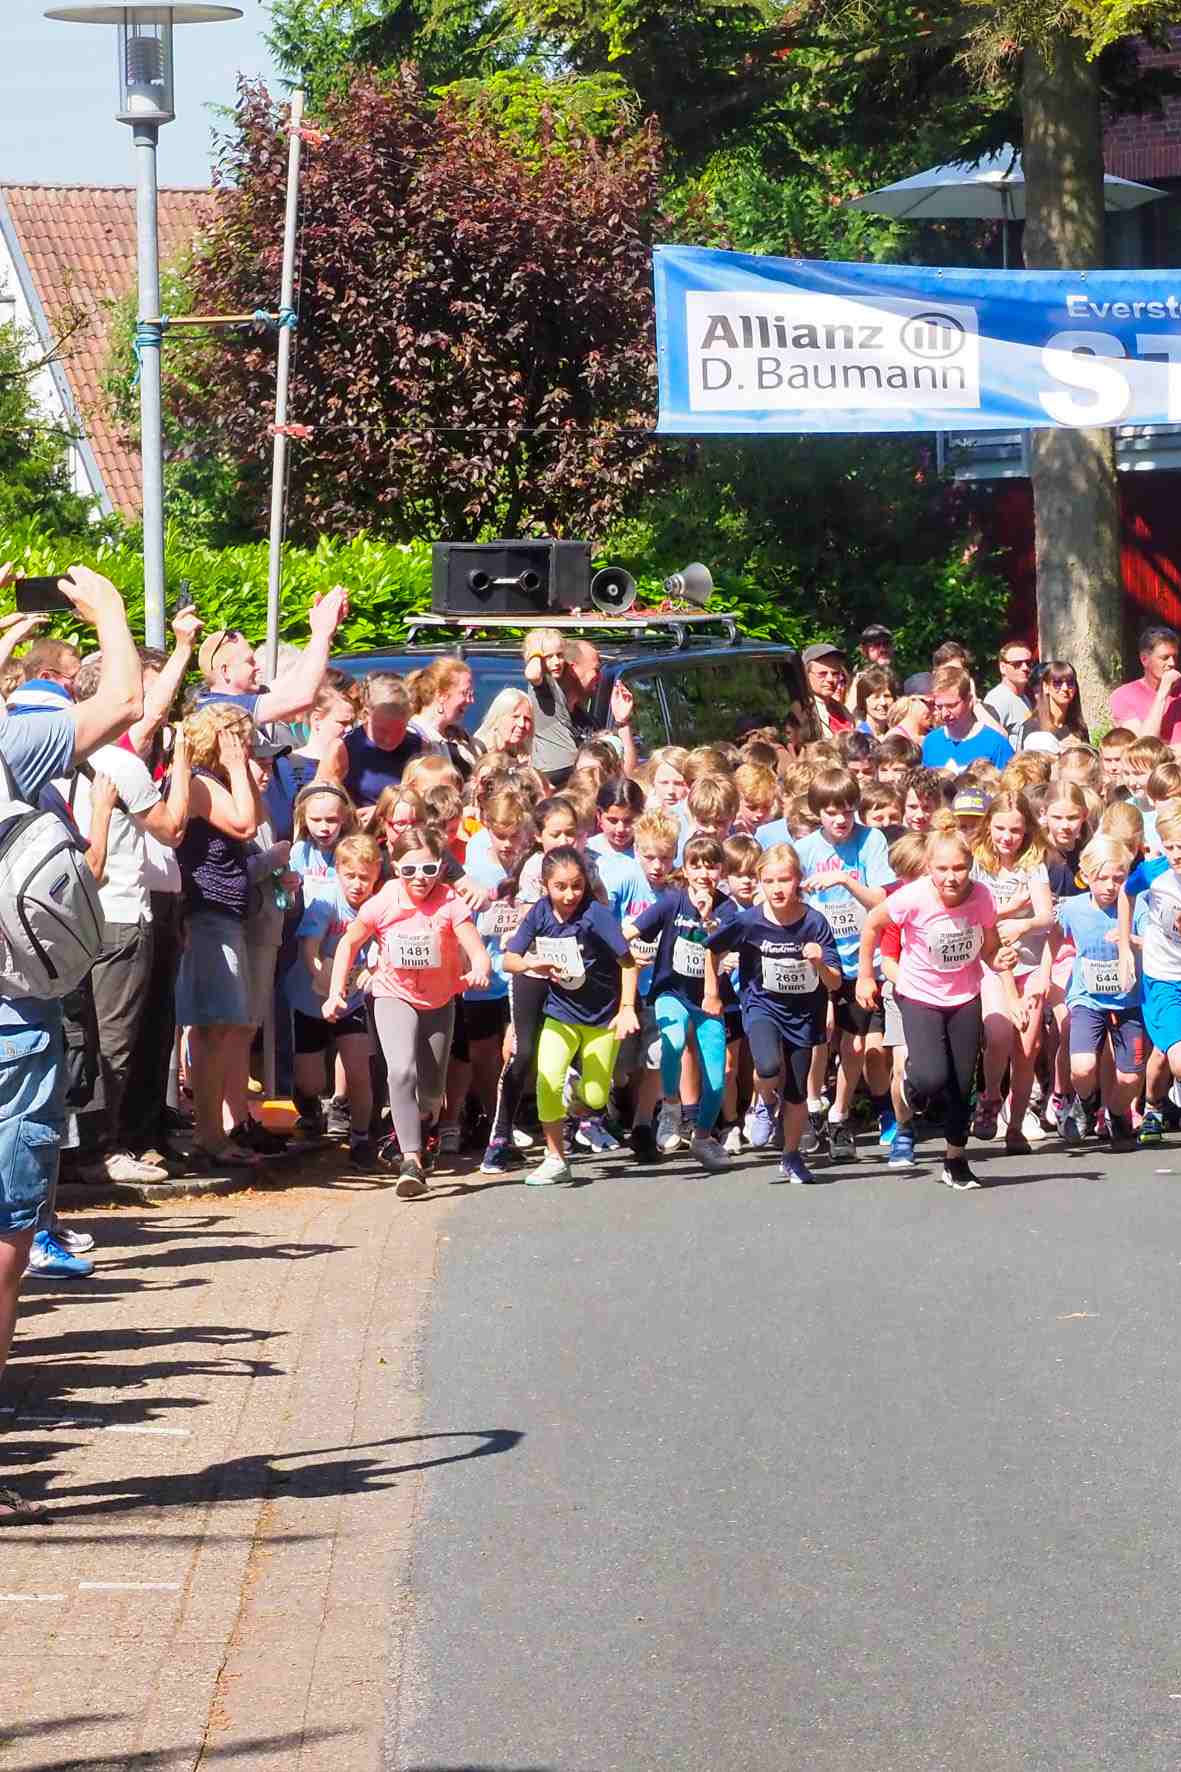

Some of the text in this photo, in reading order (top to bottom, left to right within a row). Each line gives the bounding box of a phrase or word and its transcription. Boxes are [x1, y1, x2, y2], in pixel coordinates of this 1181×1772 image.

[700, 314, 885, 350] Allianz
[701, 356, 965, 390] D. Baumann
[497, 914, 518, 923] 812
[832, 914, 855, 924] 792
[400, 946, 431, 957] 1481
[942, 941, 973, 954] 2170
[775, 973, 806, 983] 2691
[1096, 973, 1119, 982] 644
